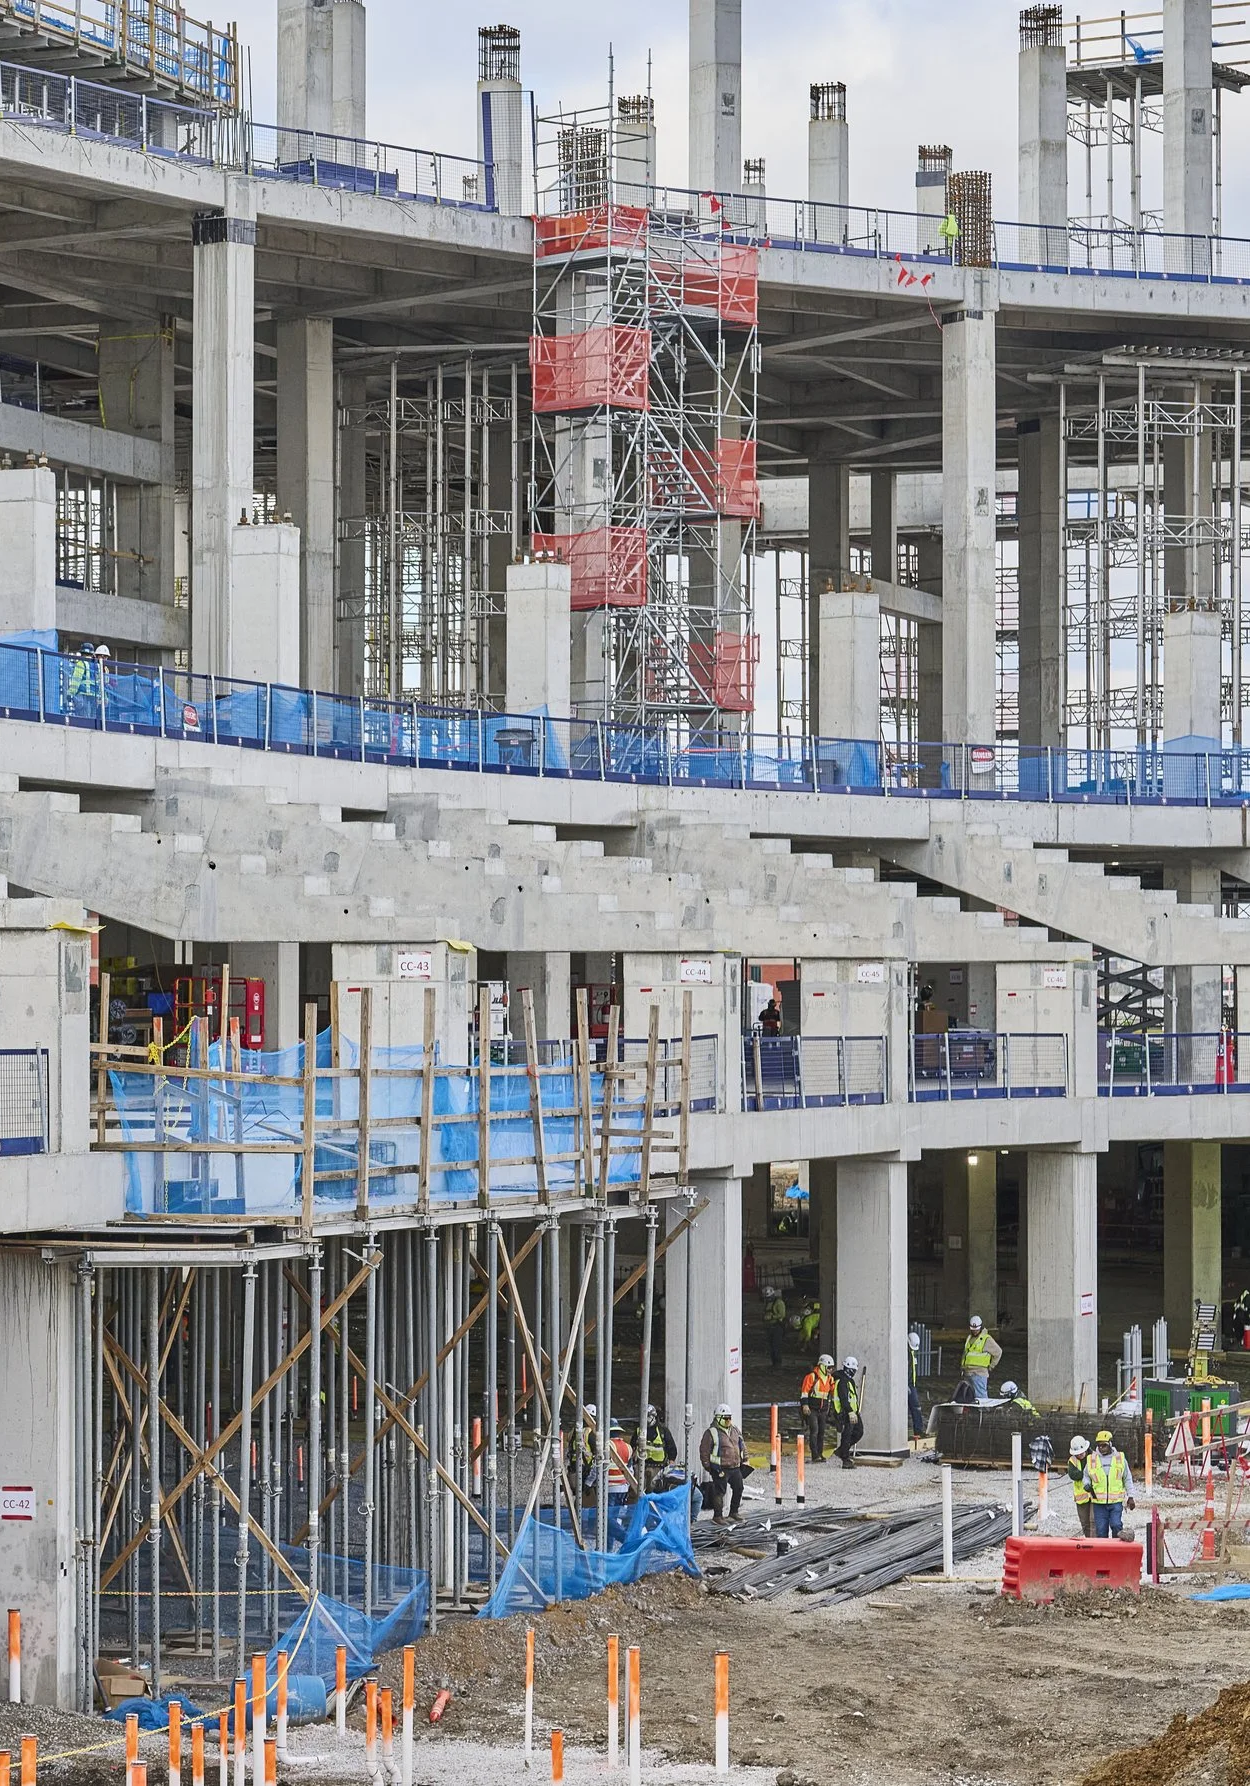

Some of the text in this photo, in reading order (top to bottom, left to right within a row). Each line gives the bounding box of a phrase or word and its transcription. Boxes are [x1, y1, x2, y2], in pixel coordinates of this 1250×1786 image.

[400, 961, 430, 972] CC-43
[685, 968, 707, 976] CC-44
[3, 1499, 30, 1509] CC-42
